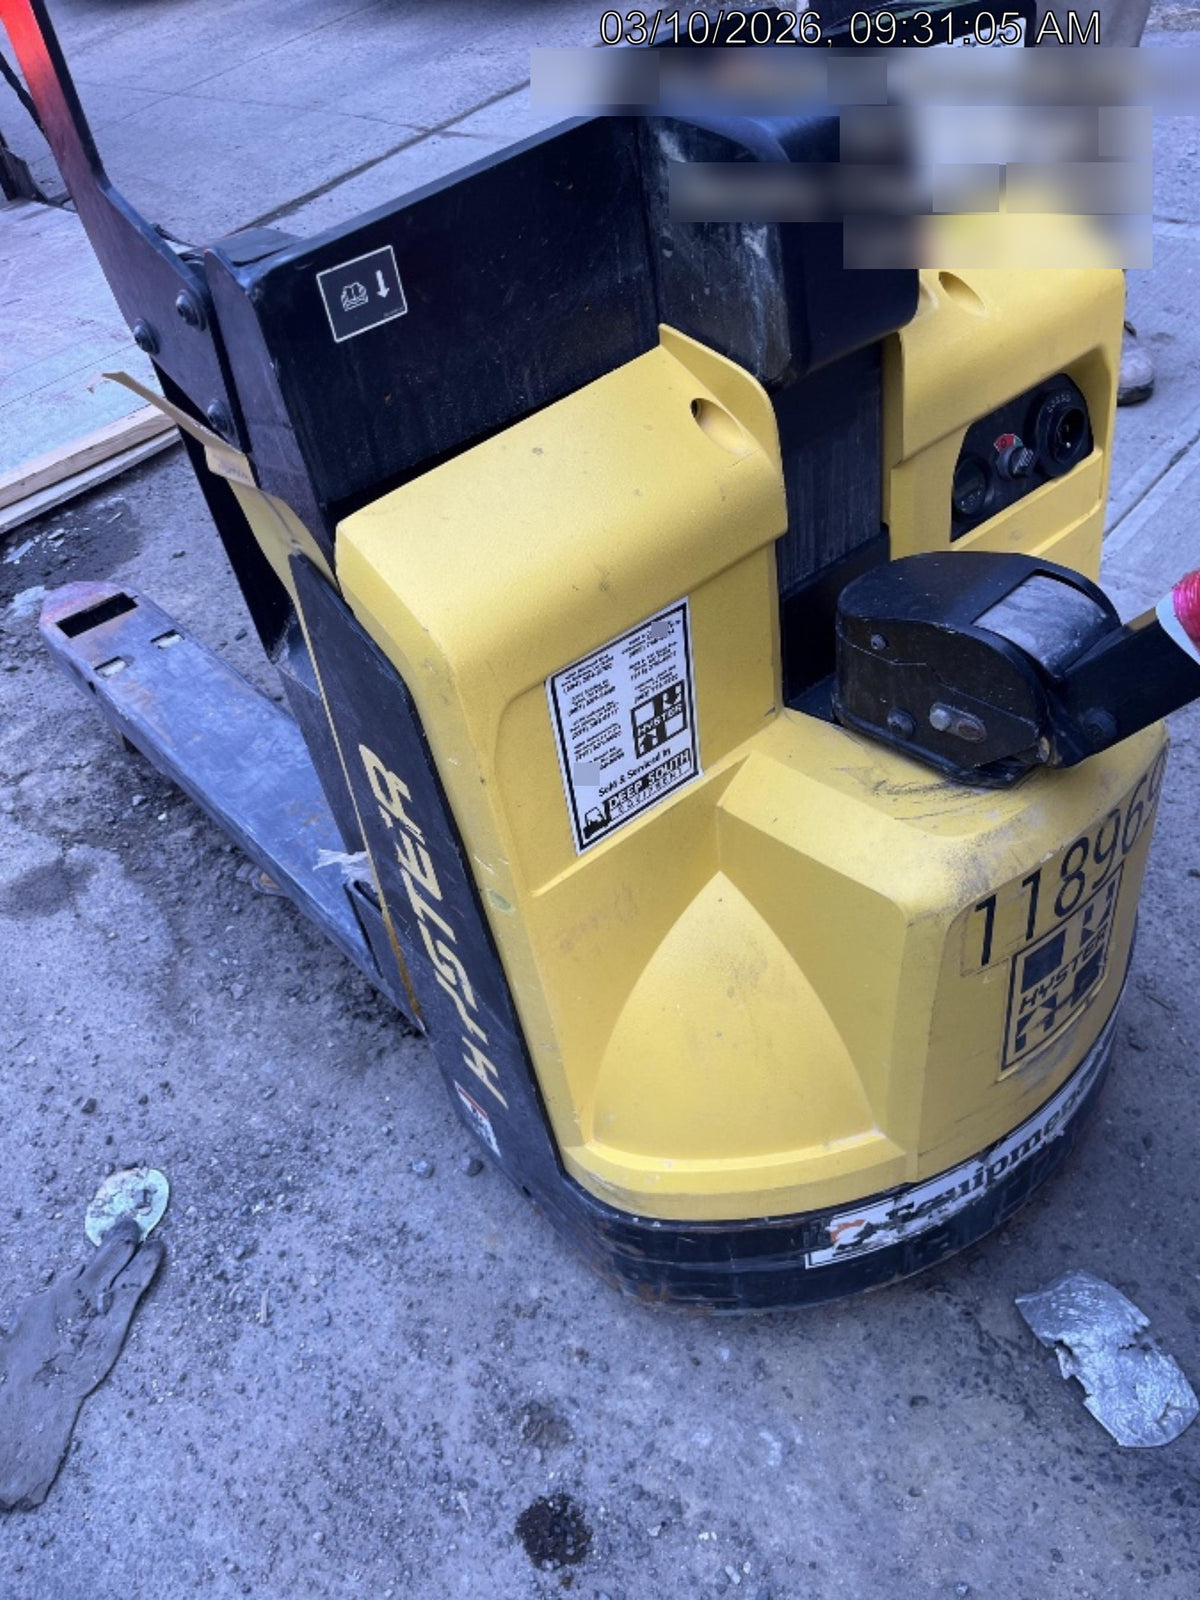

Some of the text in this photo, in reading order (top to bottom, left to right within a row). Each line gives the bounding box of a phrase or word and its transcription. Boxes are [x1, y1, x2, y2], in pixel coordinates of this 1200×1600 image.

[608, 780, 643, 810] DEEP
[648, 750, 690, 786] SOUTH
[358, 744, 509, 1110] HYSTER
[1019, 921, 1109, 1014] HYSTER
